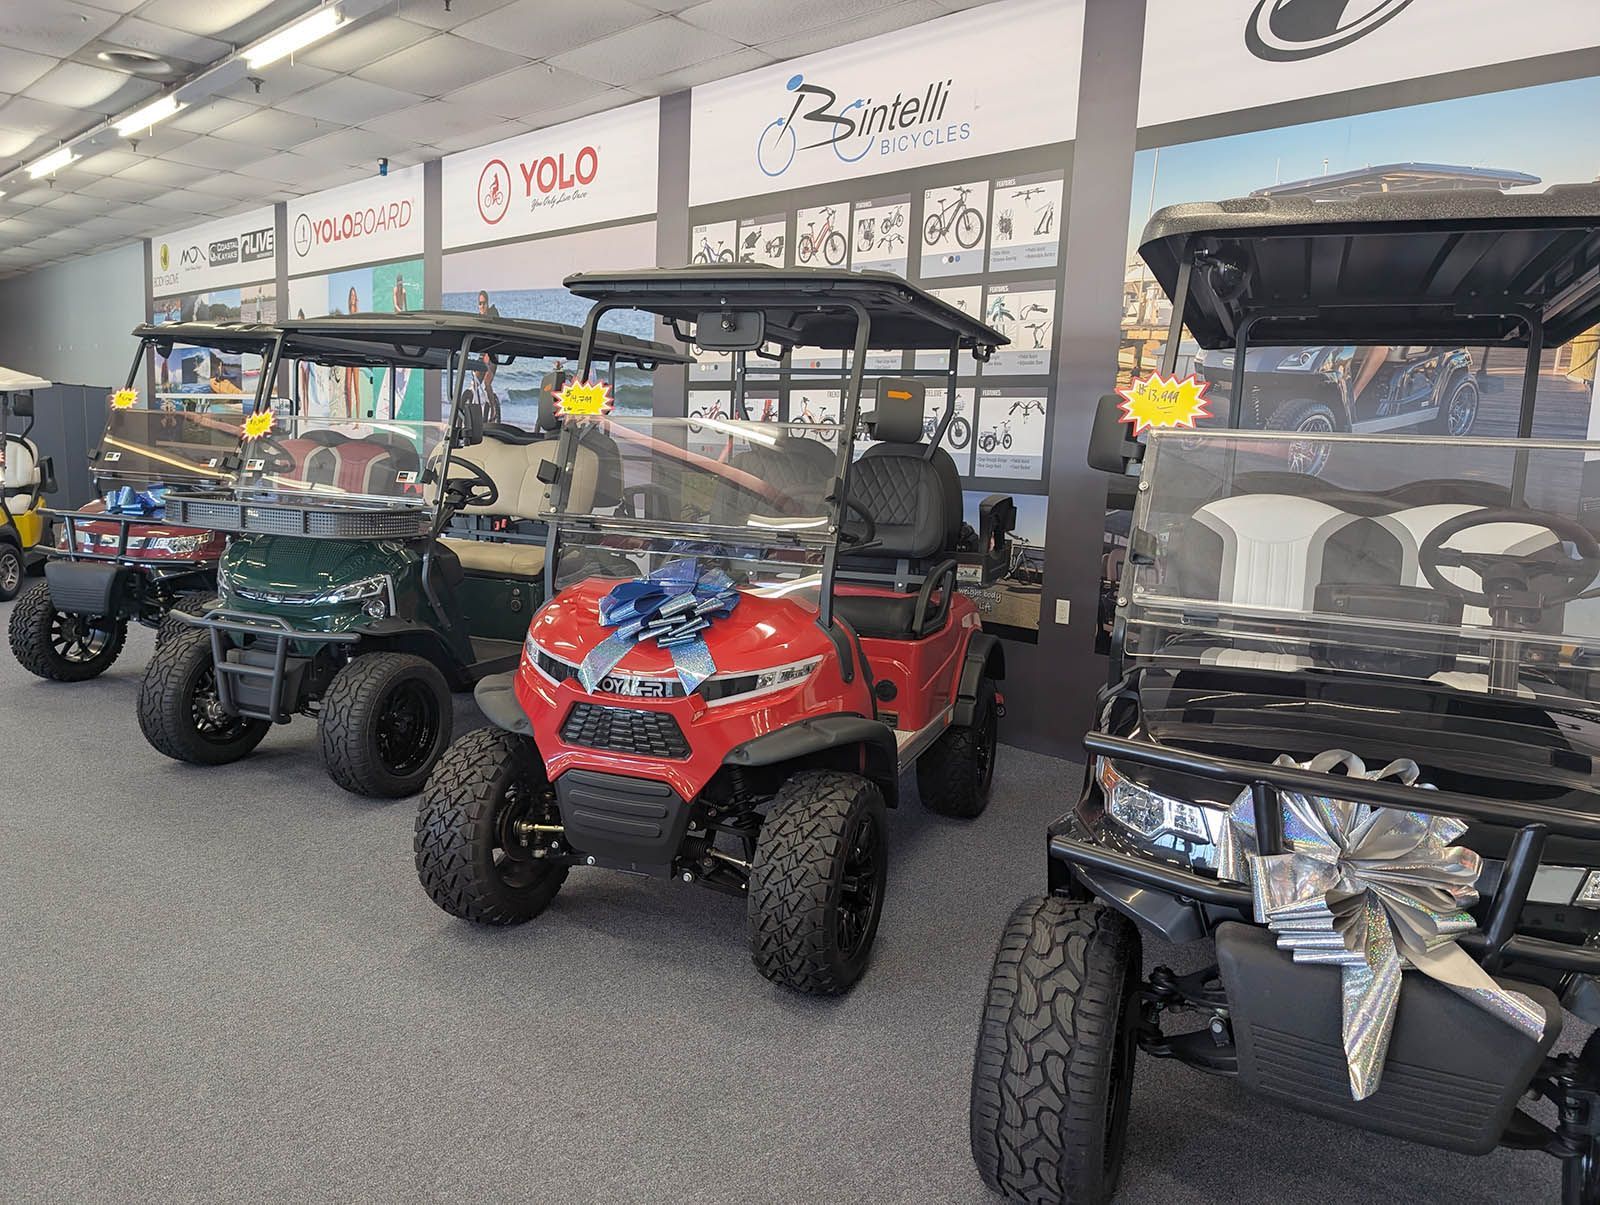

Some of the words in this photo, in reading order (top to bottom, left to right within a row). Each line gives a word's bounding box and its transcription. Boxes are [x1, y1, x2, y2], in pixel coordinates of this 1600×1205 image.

[773, 79, 953, 151] Bintelli
[880, 122, 971, 156] BICYCLES
[519, 146, 598, 197] YOLO
[312, 200, 412, 245] YOLOBOARD
[601, 677, 664, 697] OYAER
